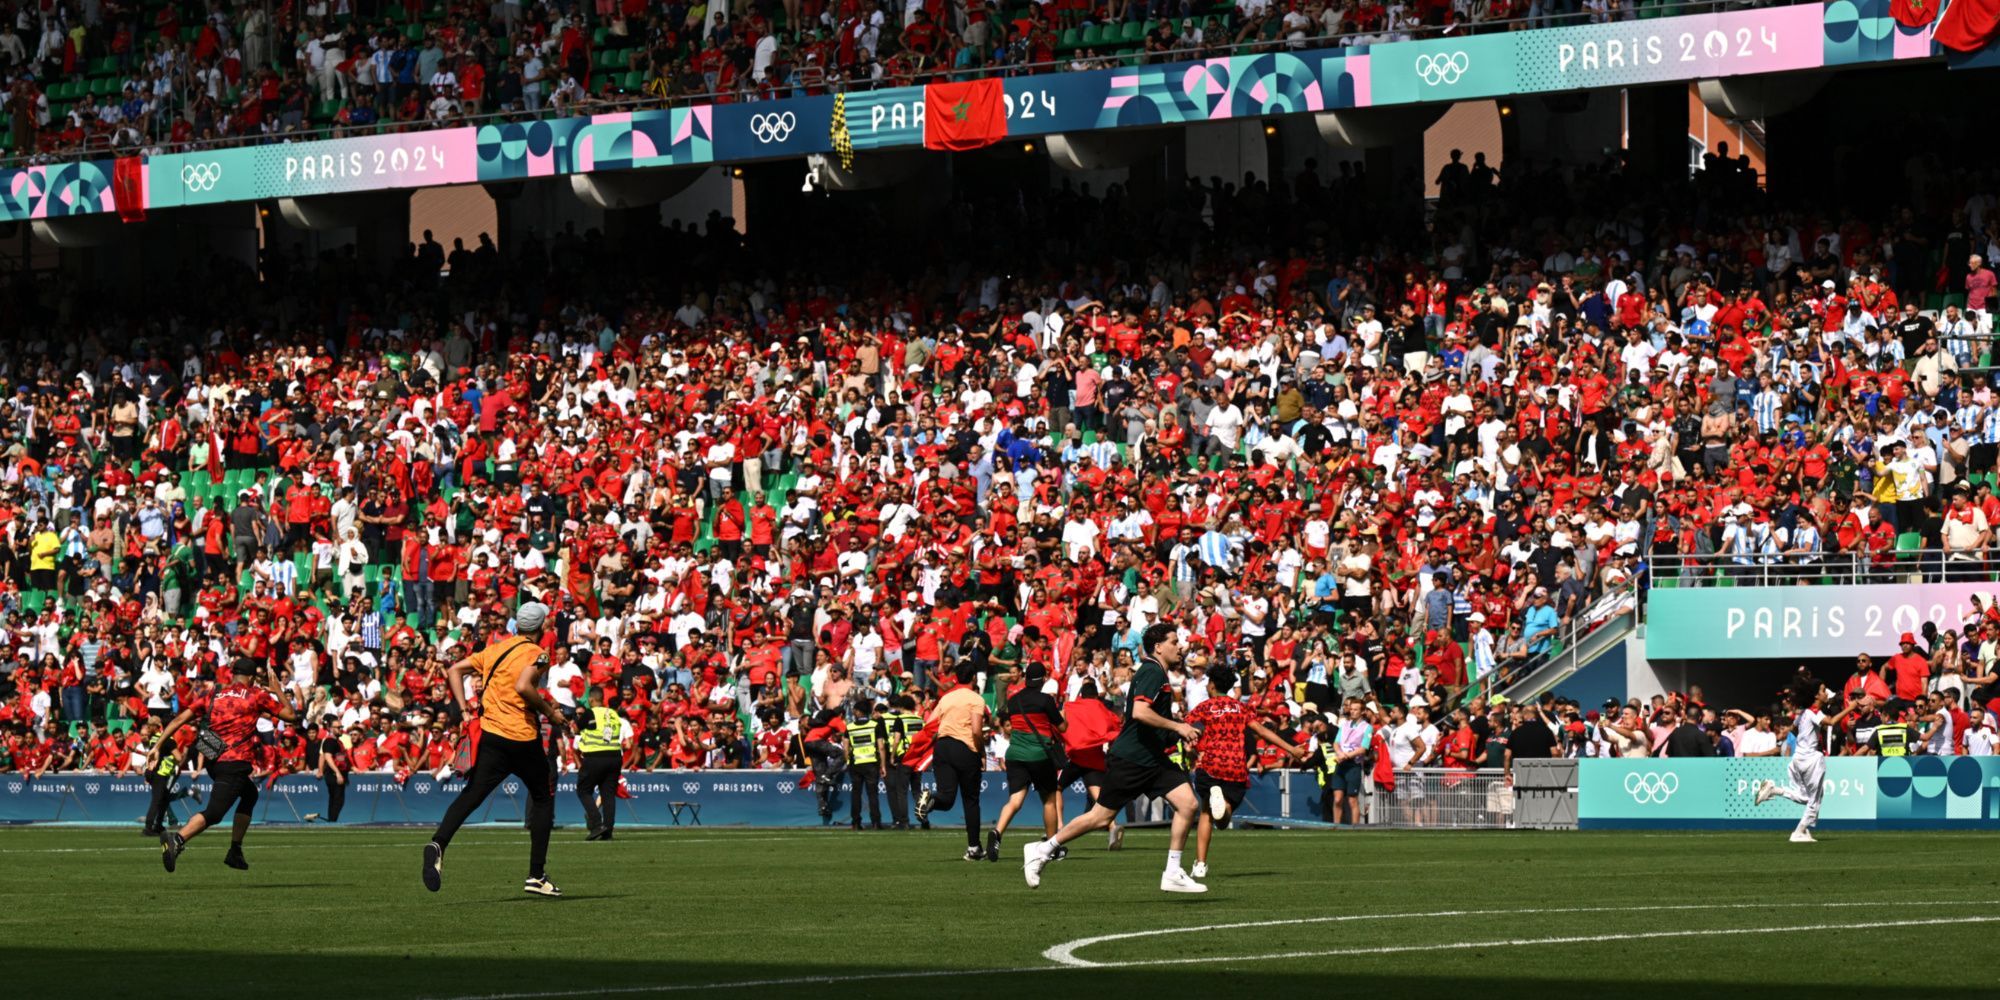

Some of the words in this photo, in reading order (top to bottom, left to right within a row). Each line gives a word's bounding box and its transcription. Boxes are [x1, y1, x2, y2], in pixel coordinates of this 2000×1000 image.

[1679, 26, 1777, 61] 2024
[872, 102, 925, 132] PAR
[373, 145, 444, 175] 2024
[298, 784, 319, 793] 2024
[626, 783, 646, 792] ARiS
[647, 783, 671, 792] 2024
[740, 783, 764, 792] 2024
[1822, 779, 1864, 796] 024
